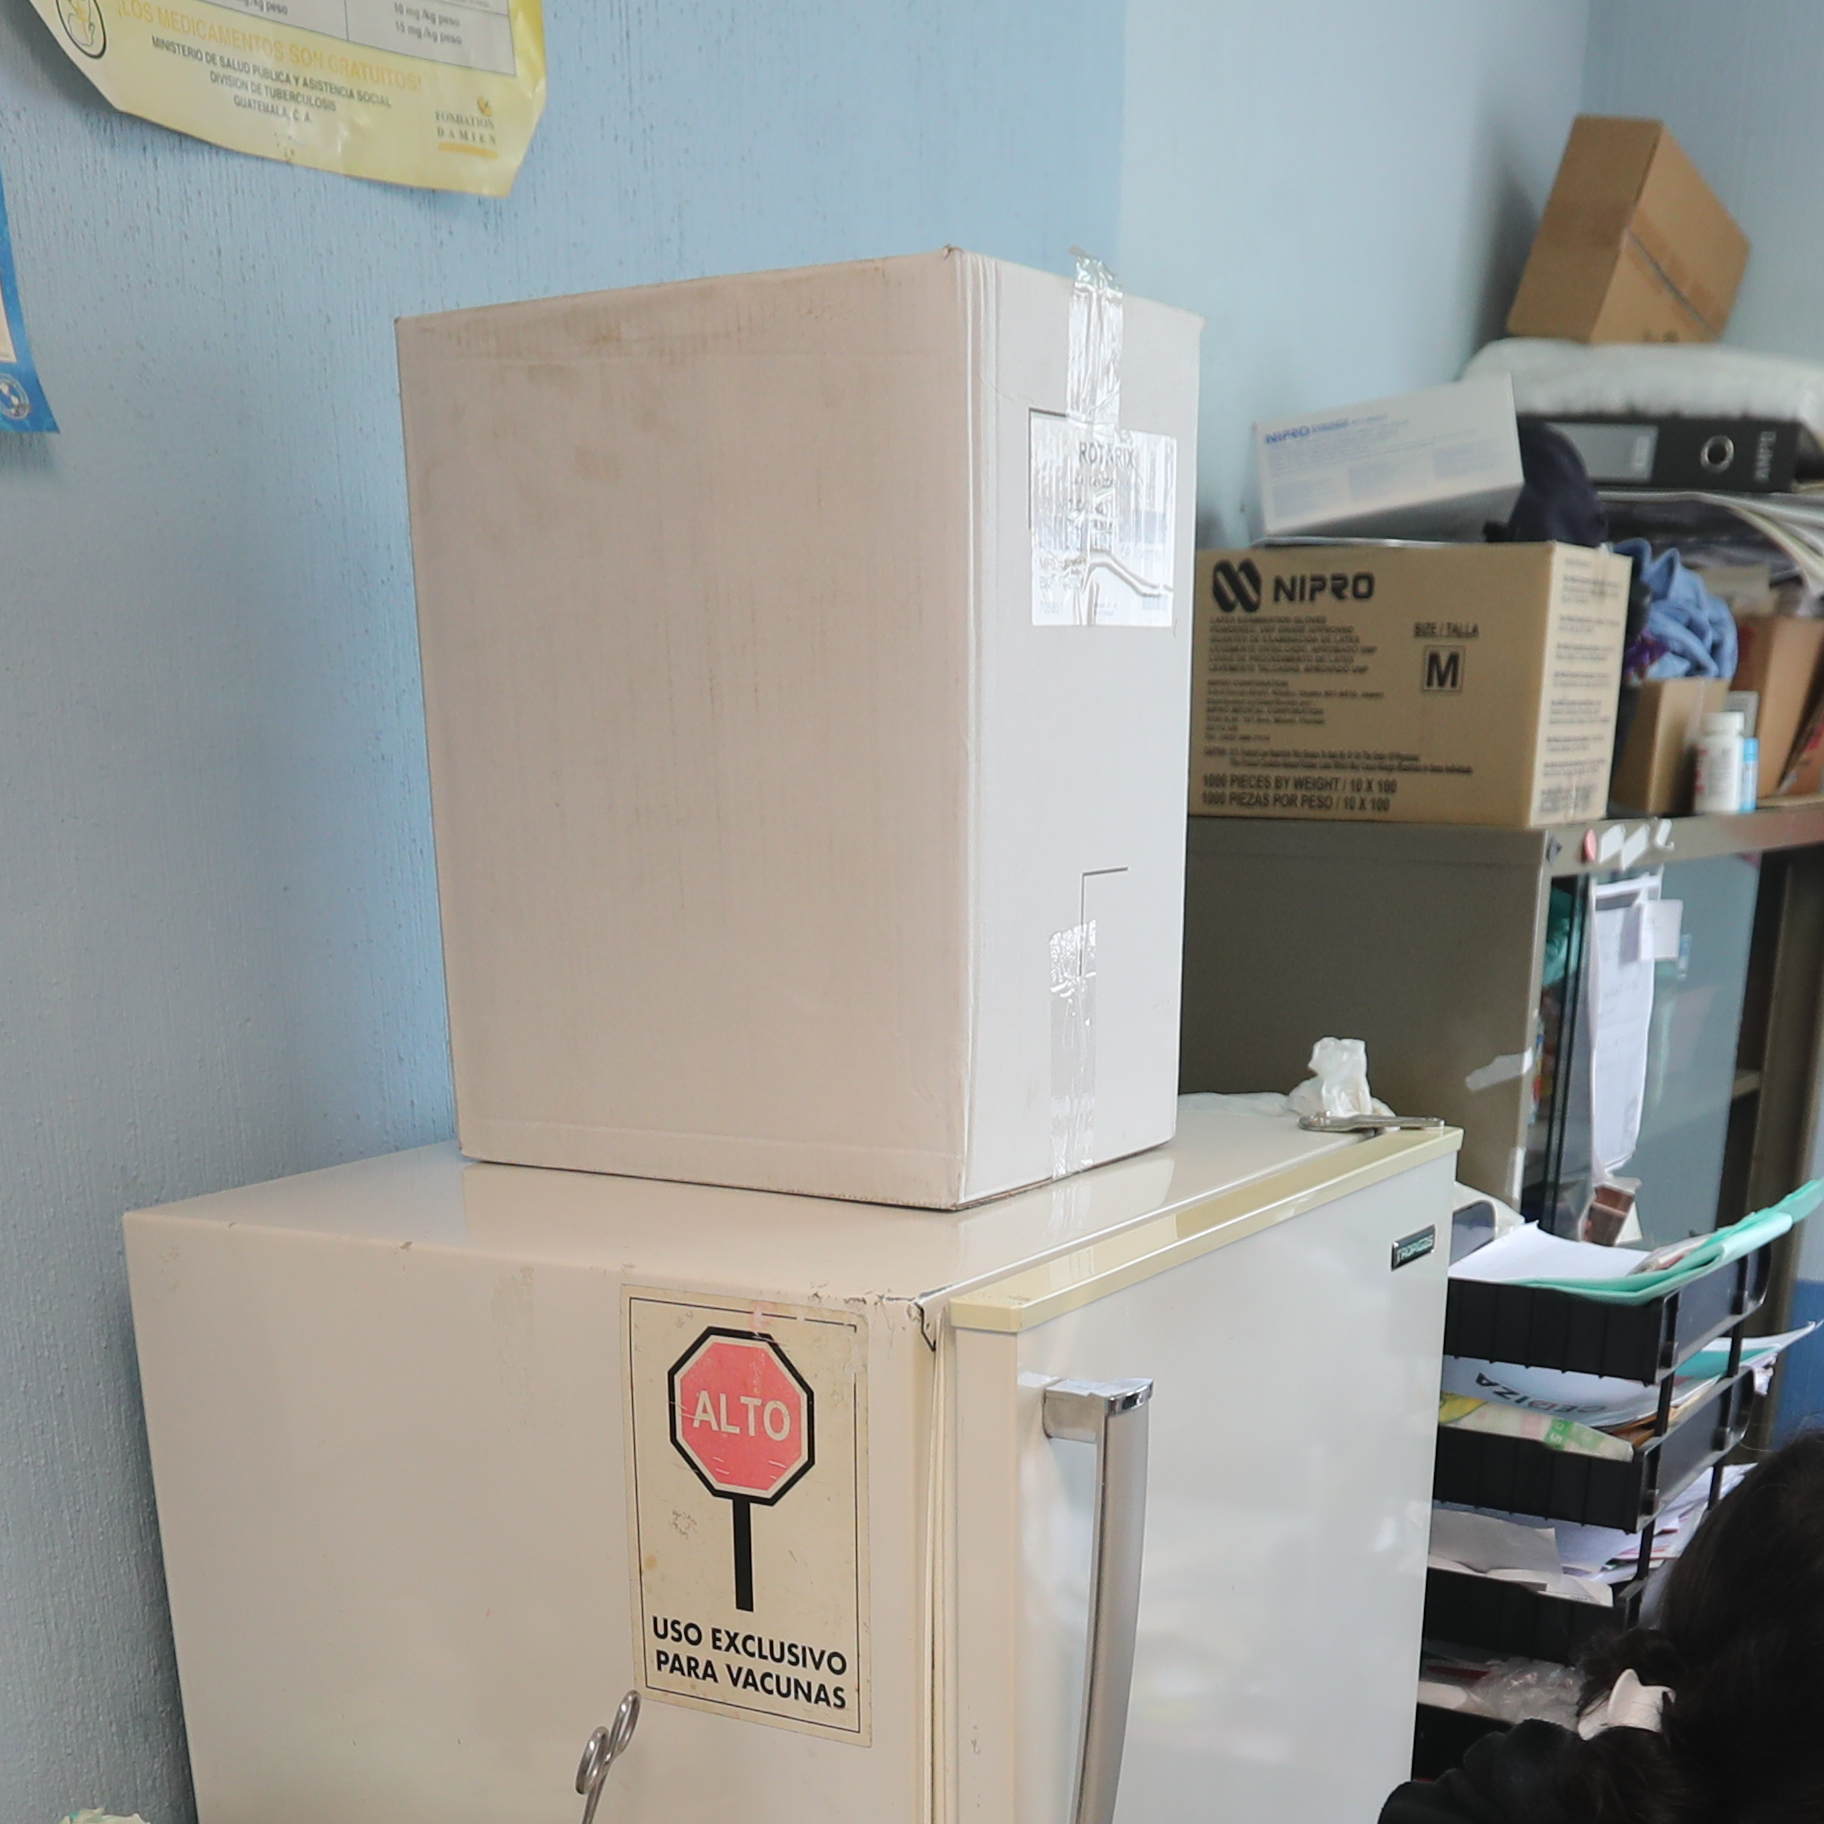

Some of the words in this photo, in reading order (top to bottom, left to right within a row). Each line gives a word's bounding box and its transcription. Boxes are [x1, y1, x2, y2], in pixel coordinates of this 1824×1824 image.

[160, 10, 284, 60] MEDICAMENTOS
[289, 45, 325, 70] SON
[328, 54, 421, 93] GRATUITOS!
[151, 35, 204, 59] MINISTERIO
[205, 51, 217, 64] DE
[219, 54, 250, 76] SALUD
[253, 64, 290, 85] PUBLICA
[294, 74, 300, 86] Y
[302, 76, 355, 99] ASISTENCIA
[356, 89, 392, 108] SOCIAL
[209, 70, 249, 92] DIVISION
[250, 81, 262, 95] DE
[263, 83, 336, 112] TUBERCULOSIS
[1078, 441, 1135, 468] ROTARIX
[1274, 571, 1375, 602] NIPRO
[1414, 622, 1439, 636] SIZE
[1446, 622, 1479, 636] TALLA
[1426, 651, 1460, 688] M
[1229, 791, 1270, 807] PIEZAS
[1272, 793, 1297, 808] POR
[1300, 794, 1333, 809] PESO
[1343, 796, 1355, 810] 10
[1358, 797, 1367, 810] X
[1230, 774, 1271, 790] PIECES
[1275, 775, 1290, 789] BY
[1293, 776, 1341, 791] WEIGHT
[1350, 778, 1362, 792] 10
[1366, 778, 1375, 792] X
[693, 1389, 792, 1441] ALTO
[652, 1615, 704, 1646] USO
[711, 1627, 847, 1676] EXCLUSIVO
[656, 1649, 718, 1684] PARA
[726, 1663, 847, 1710] VACUNAS
